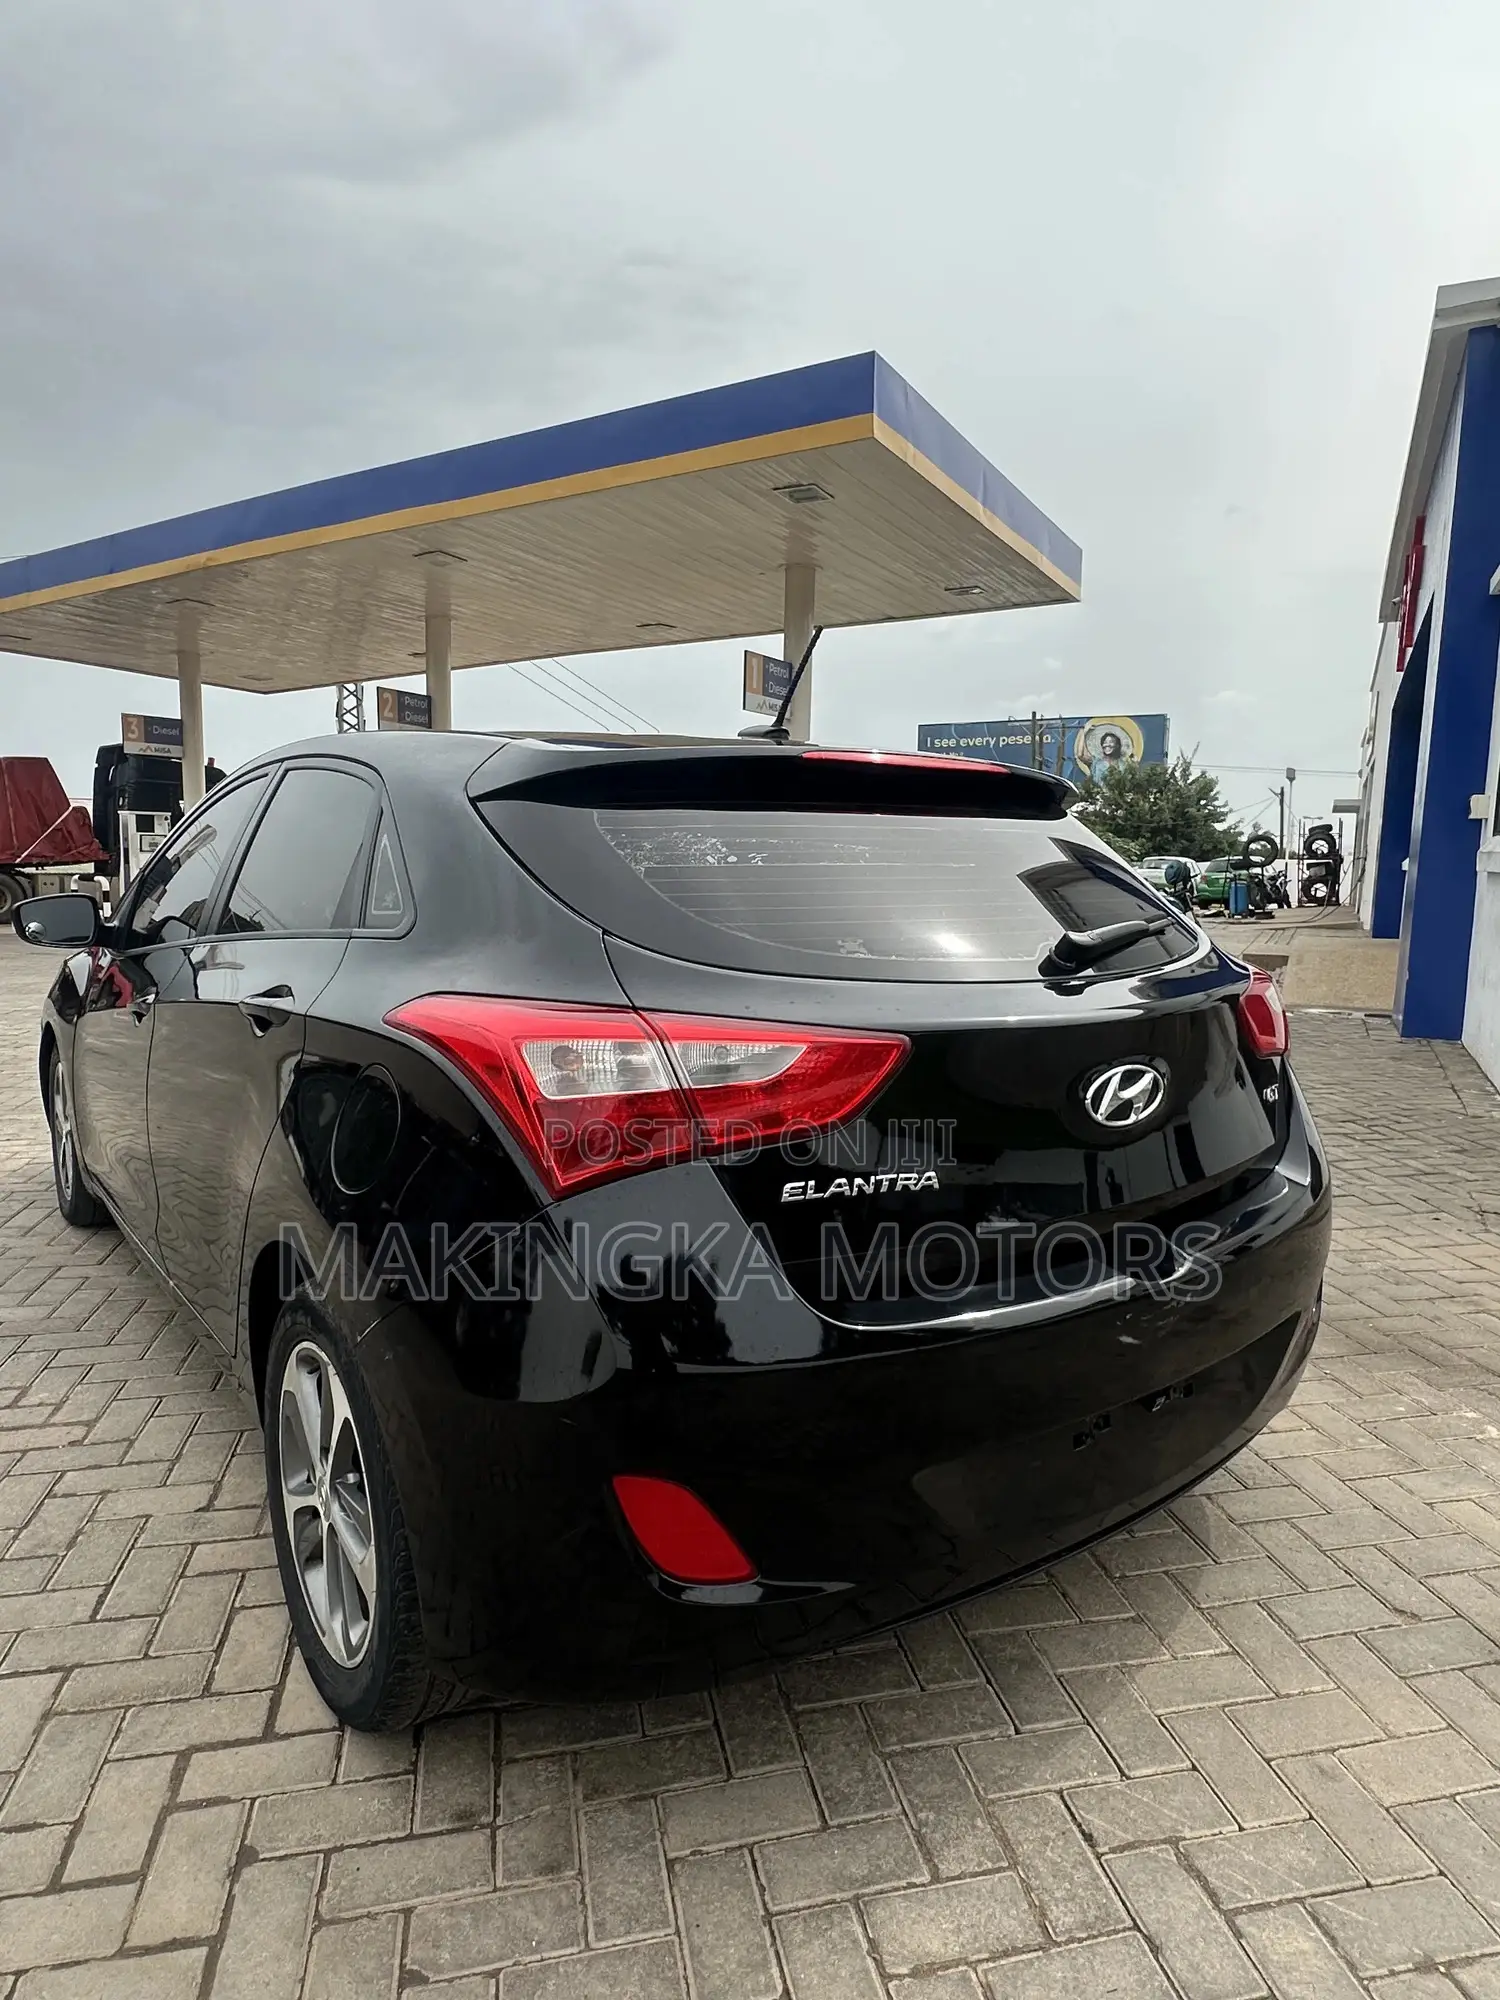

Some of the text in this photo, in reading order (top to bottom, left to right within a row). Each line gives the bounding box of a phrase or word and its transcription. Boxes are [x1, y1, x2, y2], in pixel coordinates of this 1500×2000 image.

[751, 657, 758, 689] 1
[769, 663, 789, 679] Petrol
[382, 691, 394, 718] 2
[404, 695, 428, 709] Petrol
[404, 711, 429, 724] Diesel
[127, 717, 139, 739] 3
[152, 725, 180, 736] Diesel
[934, 738, 957, 748] see
[960, 736, 997, 749] every
[780, 1170, 940, 1203] ELANTRA
